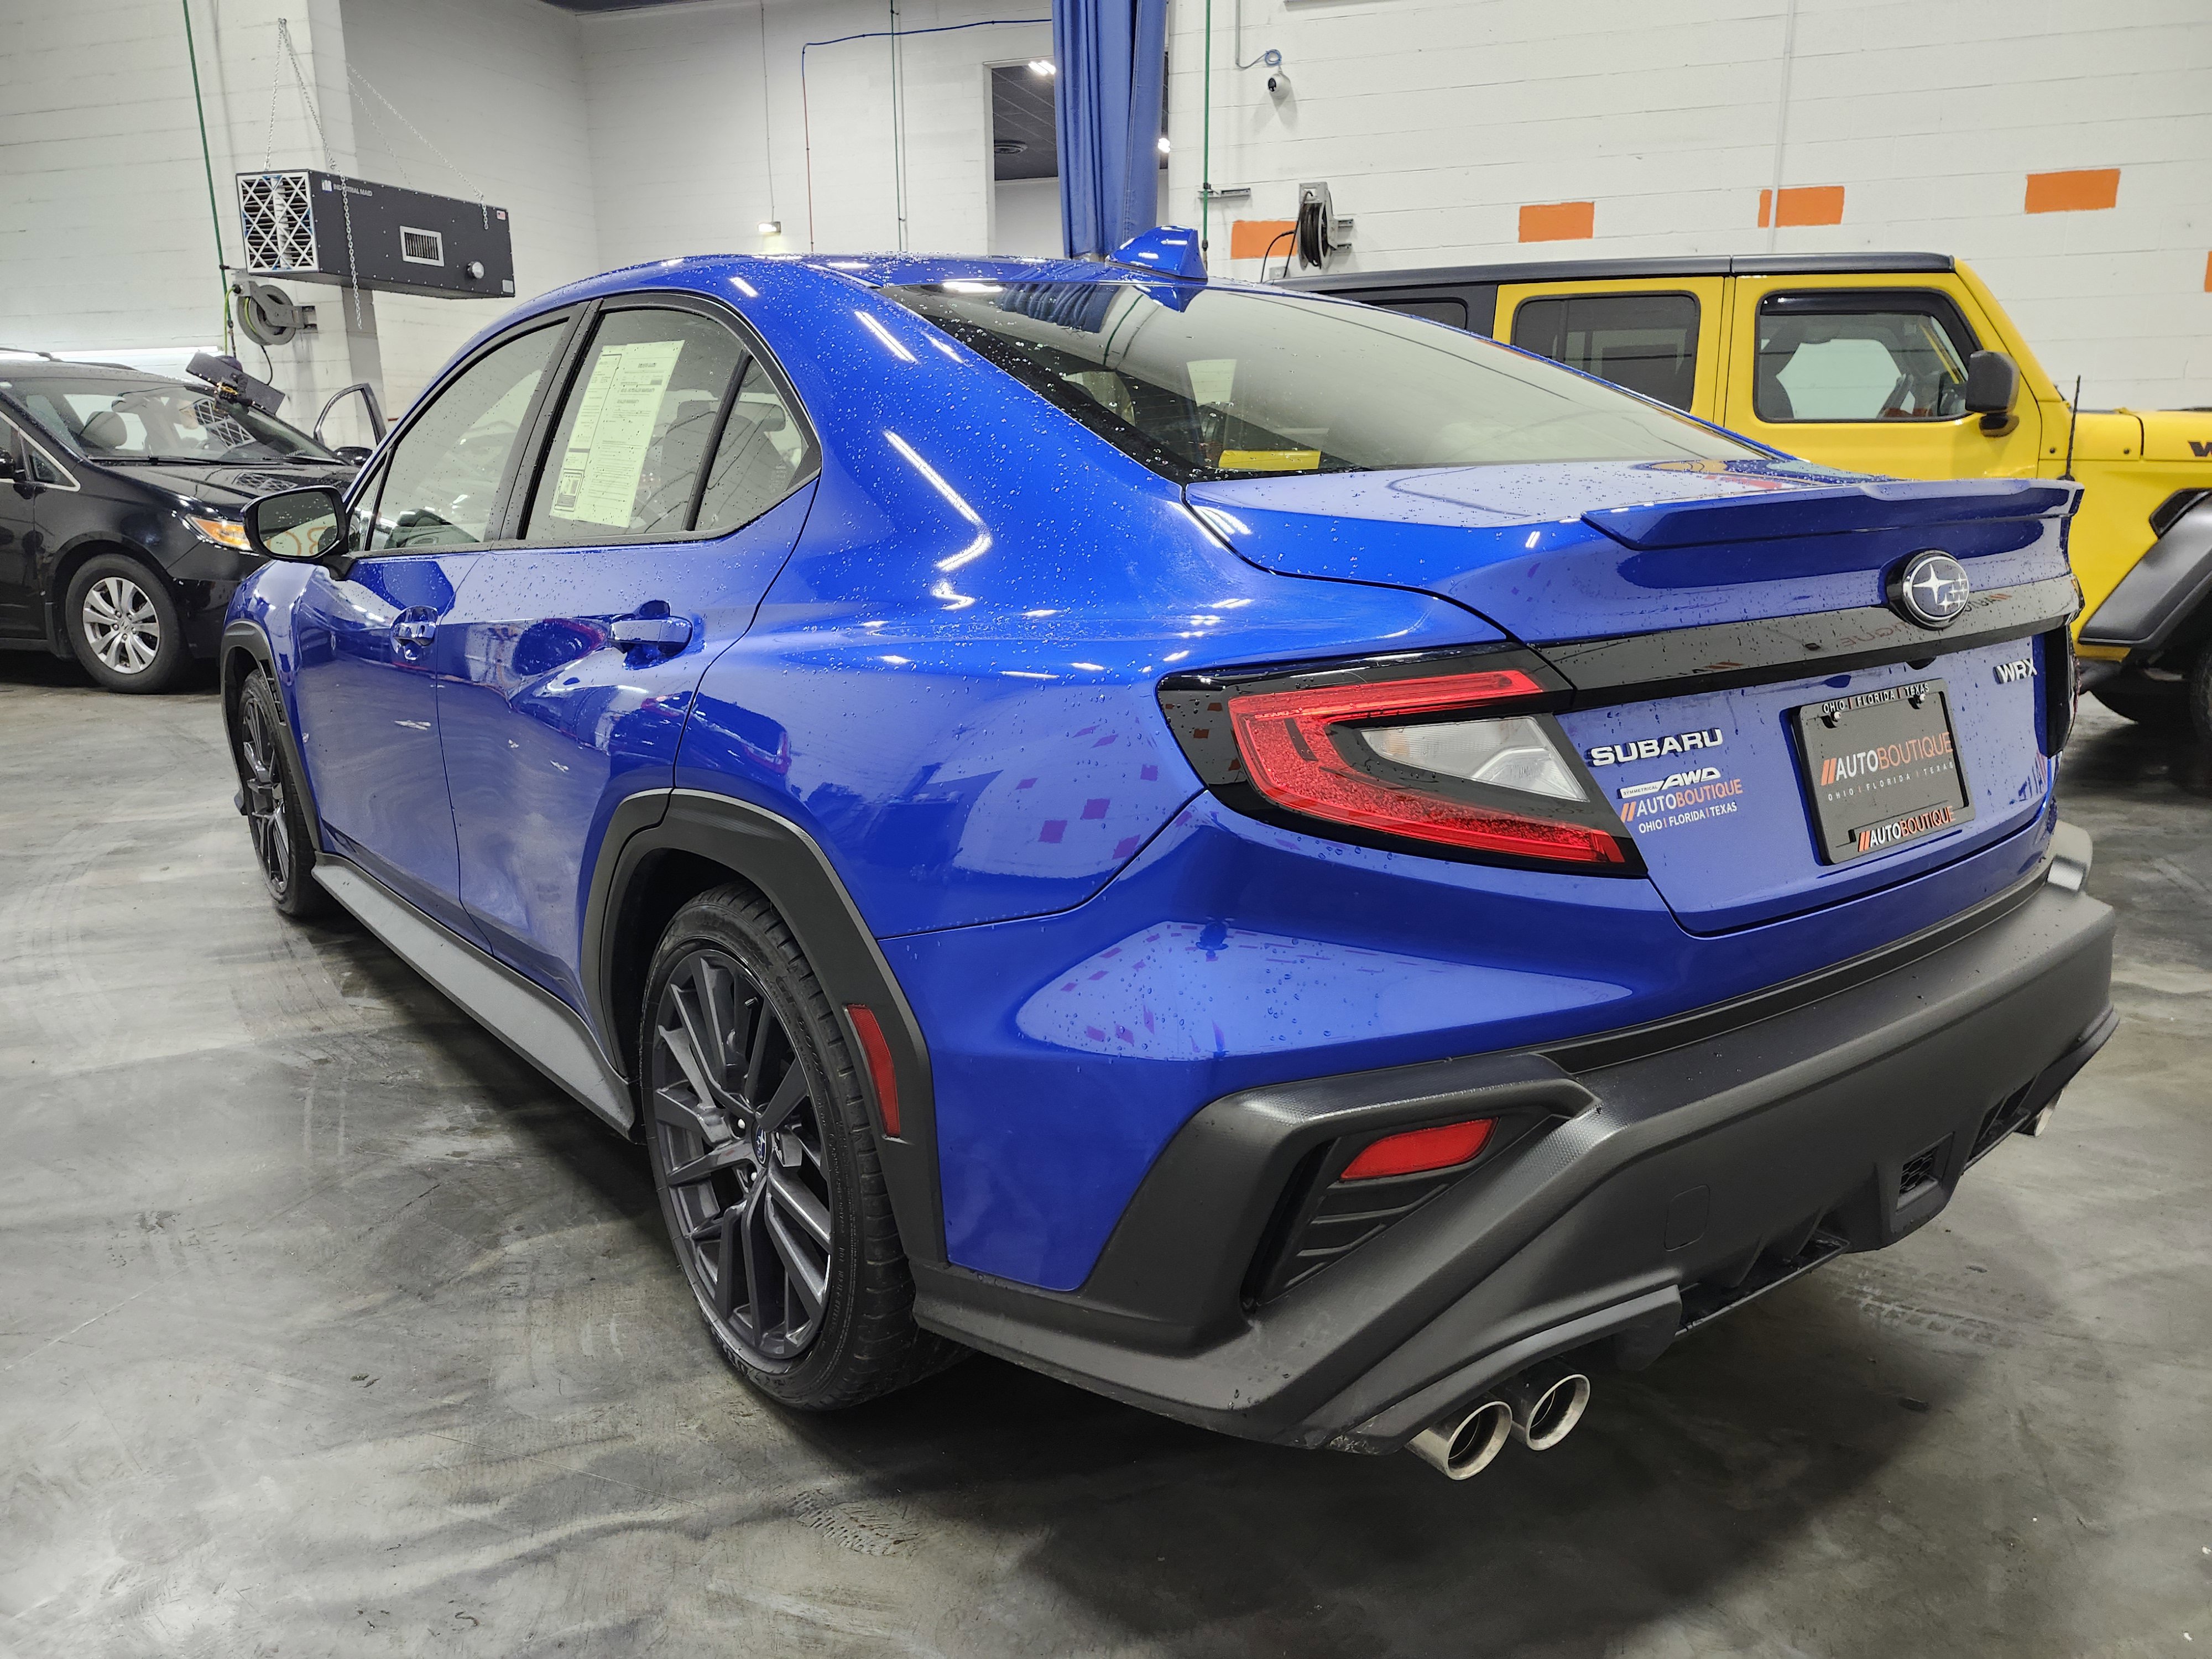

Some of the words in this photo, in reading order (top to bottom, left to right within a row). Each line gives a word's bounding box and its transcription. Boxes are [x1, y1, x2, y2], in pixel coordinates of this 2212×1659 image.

[333, 184, 359, 194] INDTRIAL
[1997, 658, 2037, 683] WRX
[1823, 701, 1845, 713] OHIO
[1857, 691, 1895, 707] FLORIDA
[1905, 684, 1929, 697] TEXAS
[1590, 728, 1723, 766] SUBARU
[1835, 732, 1954, 781] AUTOBOUTIQUE
[1623, 785, 1658, 795] SYMMETRICAL
[1661, 767, 1721, 790] AWD
[1636, 779, 1743, 817] AUTOBOUTIQUE
[1828, 788, 1855, 802] OHIO
[1866, 774, 1911, 791] FLORIDA
[1923, 761, 1954, 776] TEXAS
[1639, 819, 1662, 834] OHIO
[1668, 811, 1705, 827] FLORIDA
[1710, 802, 1738, 817] TEXAS
[1869, 806, 1956, 848] AUTOBOUTIQUE
